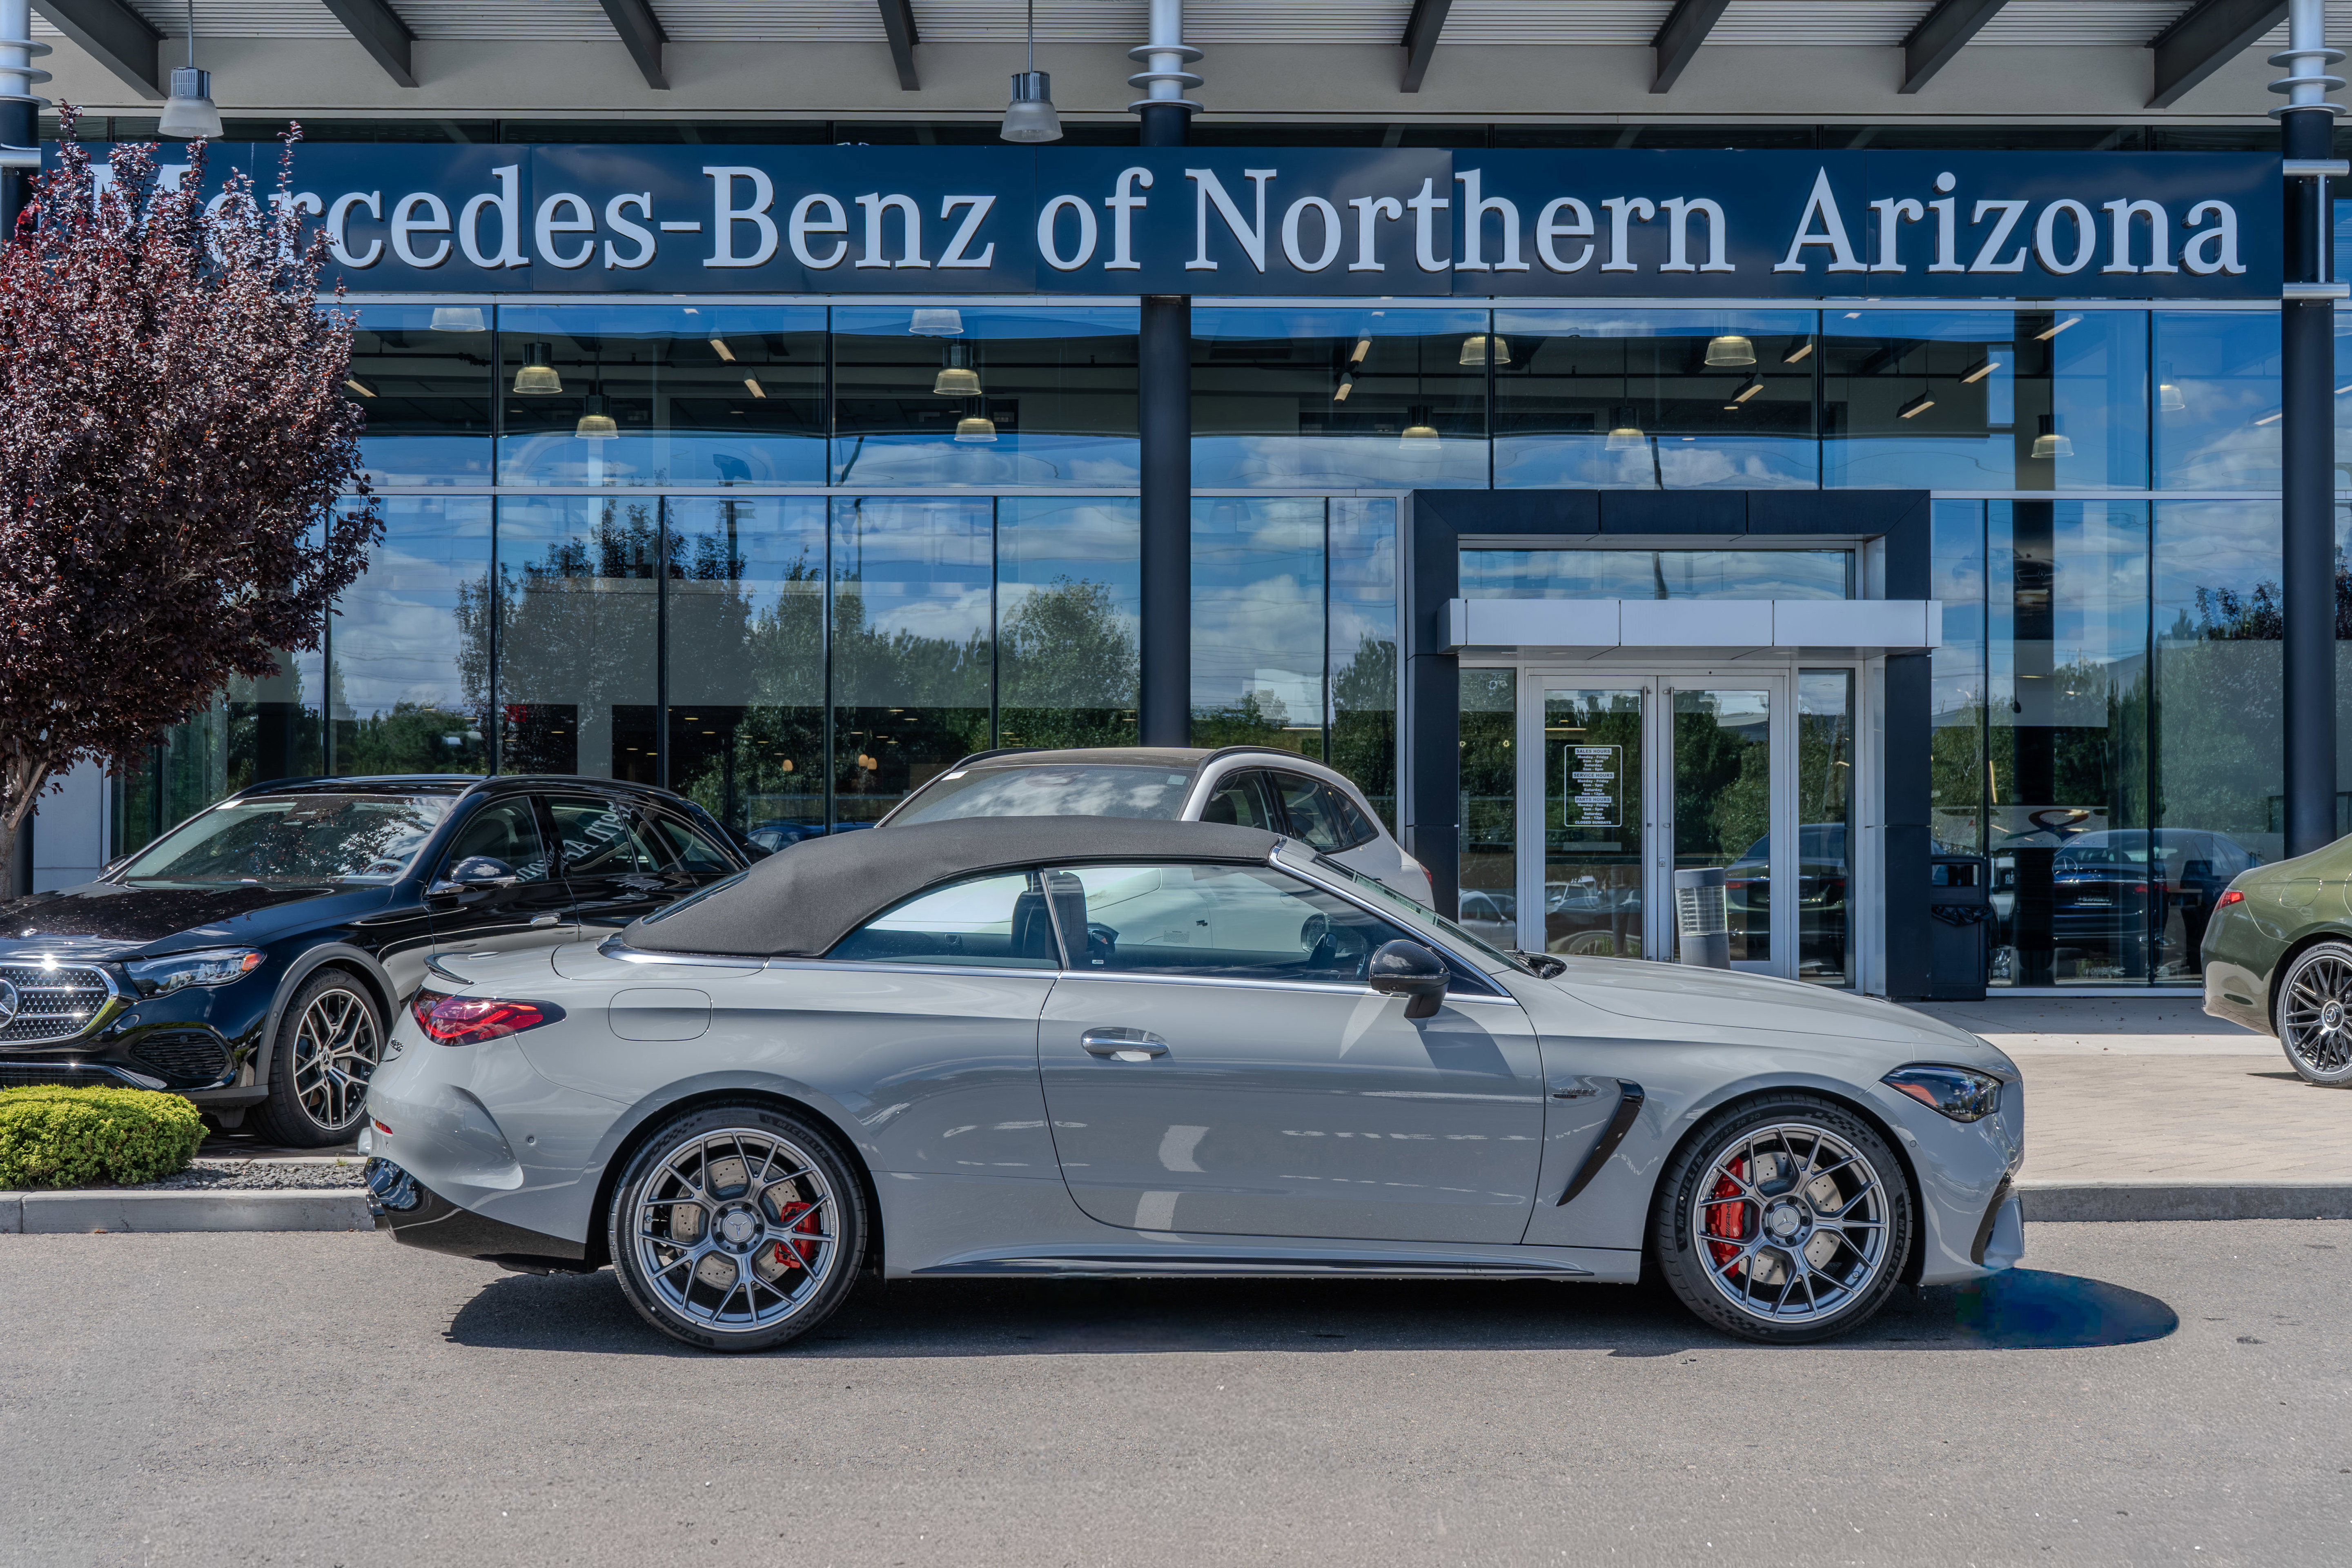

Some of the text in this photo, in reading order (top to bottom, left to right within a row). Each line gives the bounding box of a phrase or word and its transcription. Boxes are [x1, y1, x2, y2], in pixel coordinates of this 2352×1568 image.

[1038, 167, 1153, 270] of
[1186, 168, 1736, 272] Northern
[1775, 167, 2247, 274] Arizona
[314, 976, 338, 991] ZERO
[777, 1120, 828, 1158] MICHELIN
[1677, 1154, 1704, 1227] MICHELIN
[1707, 1126, 1734, 1150] 265/35
[1736, 1118, 1746, 1127] ZR
[1879, 1218, 1905, 1291] MICHELIN
